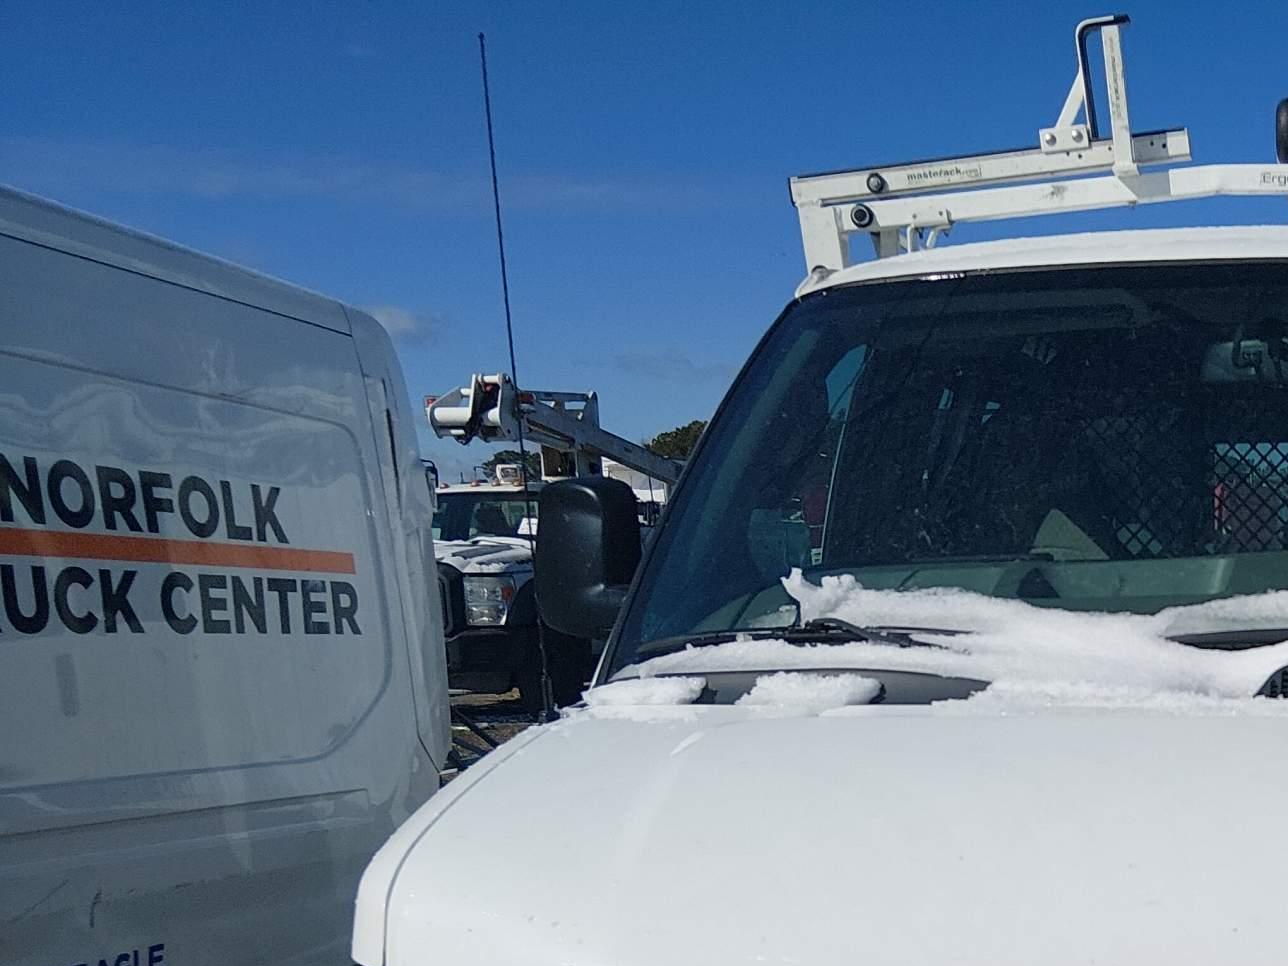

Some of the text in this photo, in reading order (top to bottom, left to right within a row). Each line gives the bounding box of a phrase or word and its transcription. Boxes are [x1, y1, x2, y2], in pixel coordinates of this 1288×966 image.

[0, 454, 289, 544] NORFOLK
[0, 563, 363, 636] UCK CENTER
